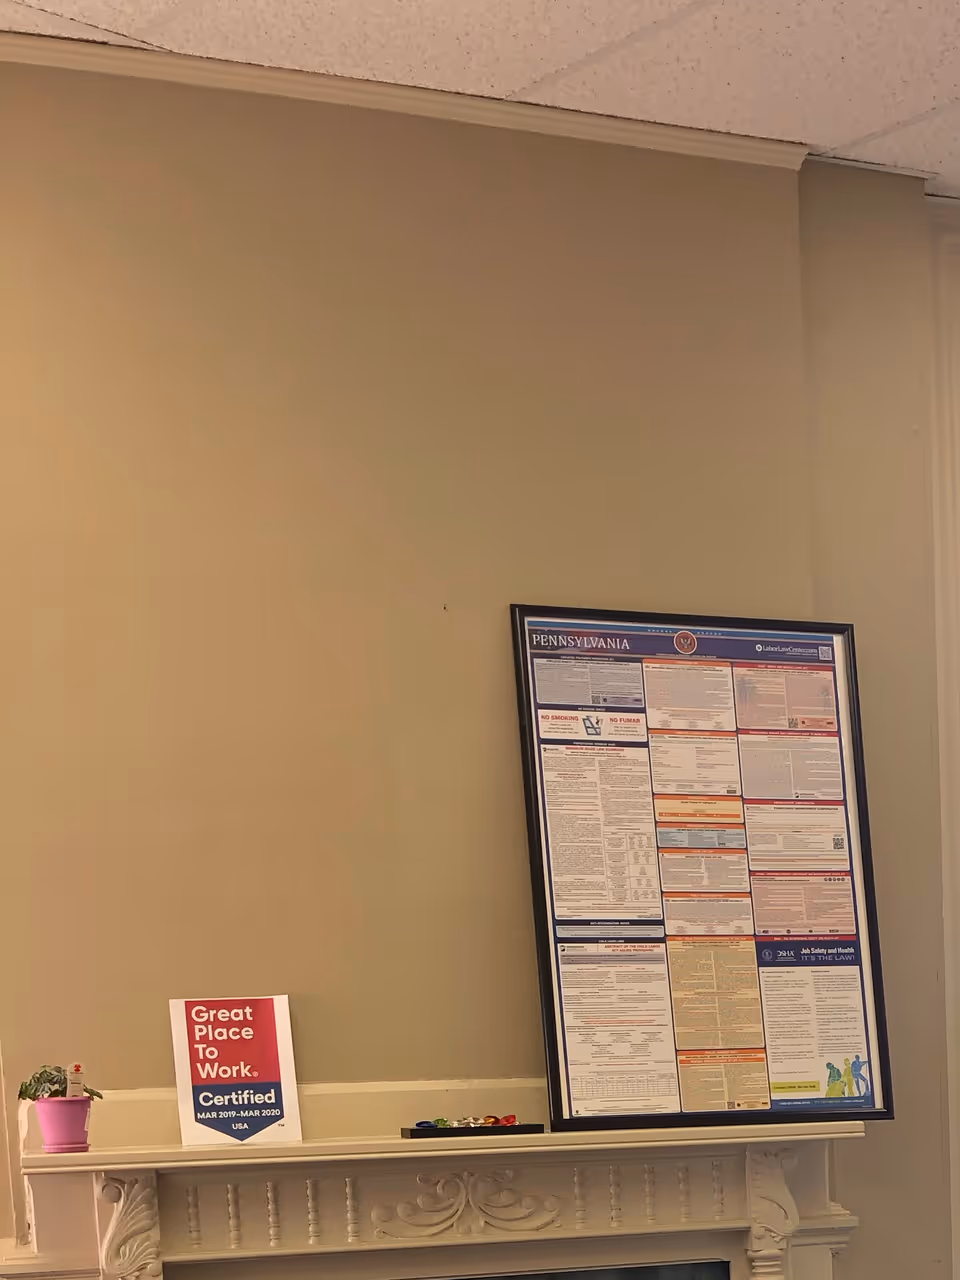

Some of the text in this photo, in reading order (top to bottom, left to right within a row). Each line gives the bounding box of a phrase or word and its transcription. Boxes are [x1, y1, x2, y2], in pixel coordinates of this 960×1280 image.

[532, 634, 630, 650] PENNSYLVANIA
[811, 947, 827, 955] Safety
[191, 1005, 253, 1022] Great
[194, 1024, 254, 1041] Place
[194, 1044, 219, 1060] To
[198, 1088, 276, 1107] Certified
[197, 1111, 217, 1119] MAR
[261, 1108, 281, 1117] 2020
